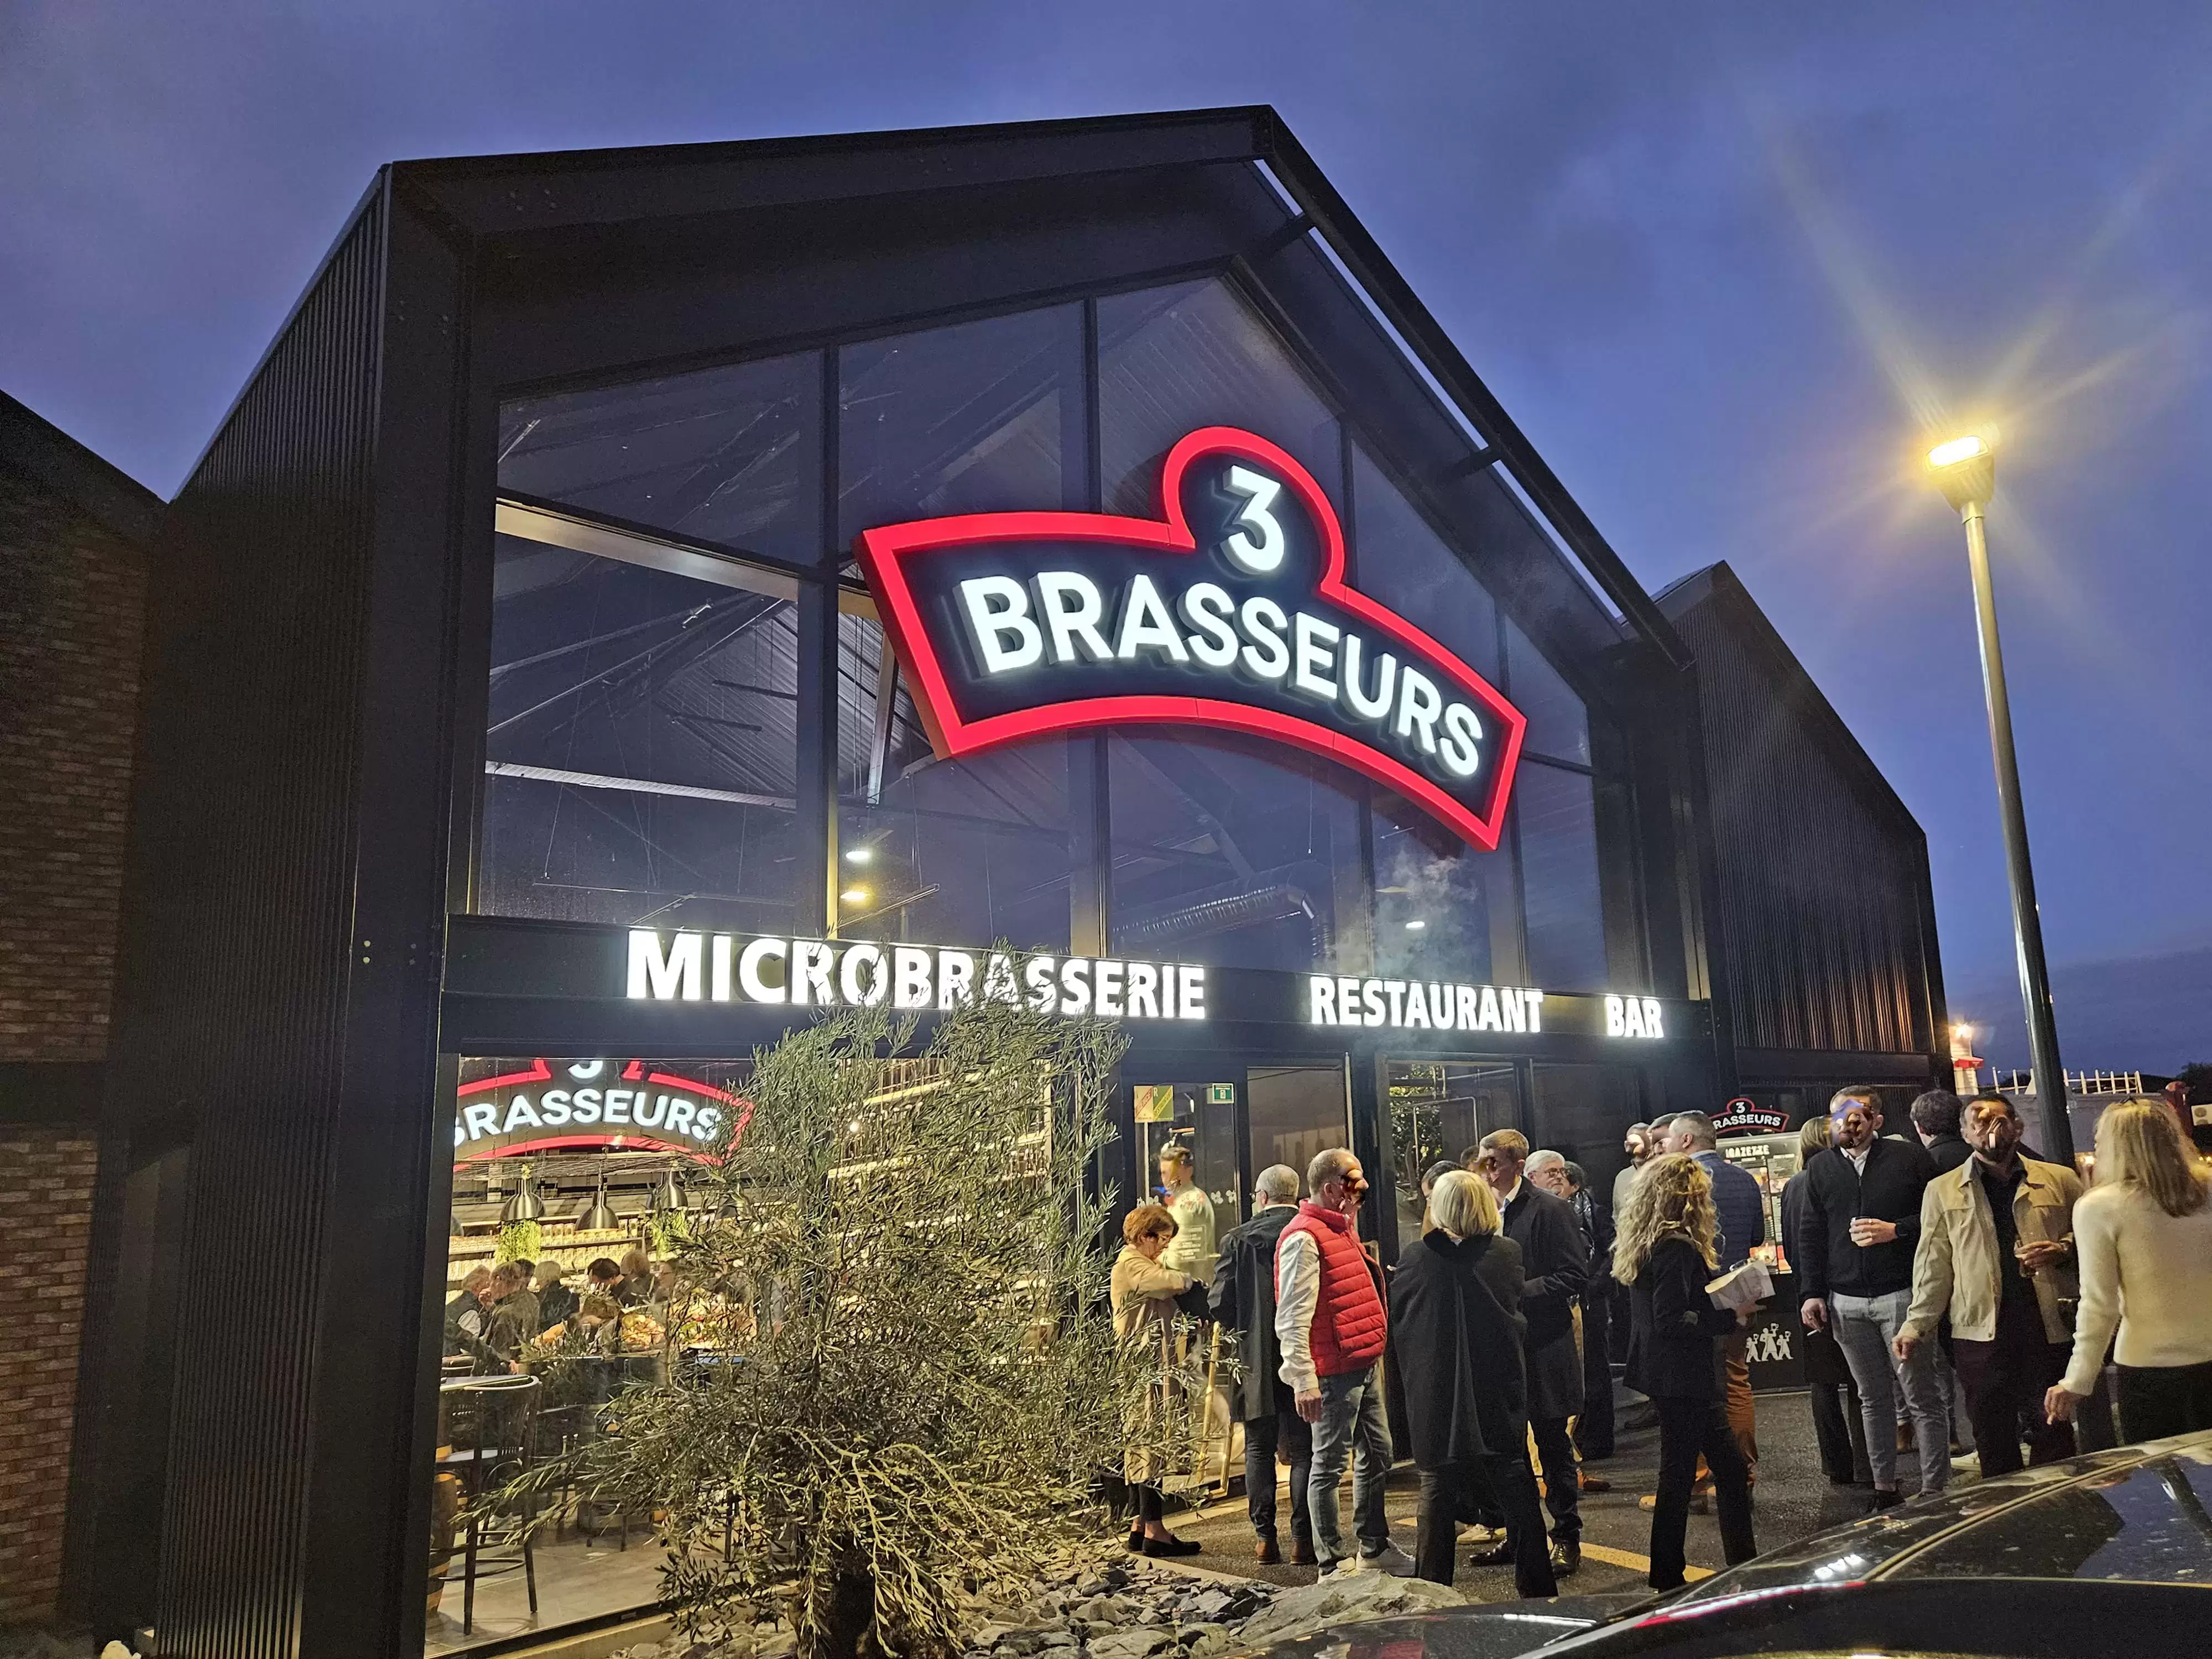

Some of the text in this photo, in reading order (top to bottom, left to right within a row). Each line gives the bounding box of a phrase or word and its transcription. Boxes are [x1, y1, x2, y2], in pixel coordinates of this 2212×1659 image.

[1229, 465, 1285, 571] 3
[960, 571, 1483, 776] BRASSEURS
[627, 930, 1665, 1039] MICROBRASSERIE RESTAURANT BAR
[1713, 1114, 1781, 1129] RASSEURS
[1736, 1102, 1745, 1114] 3
